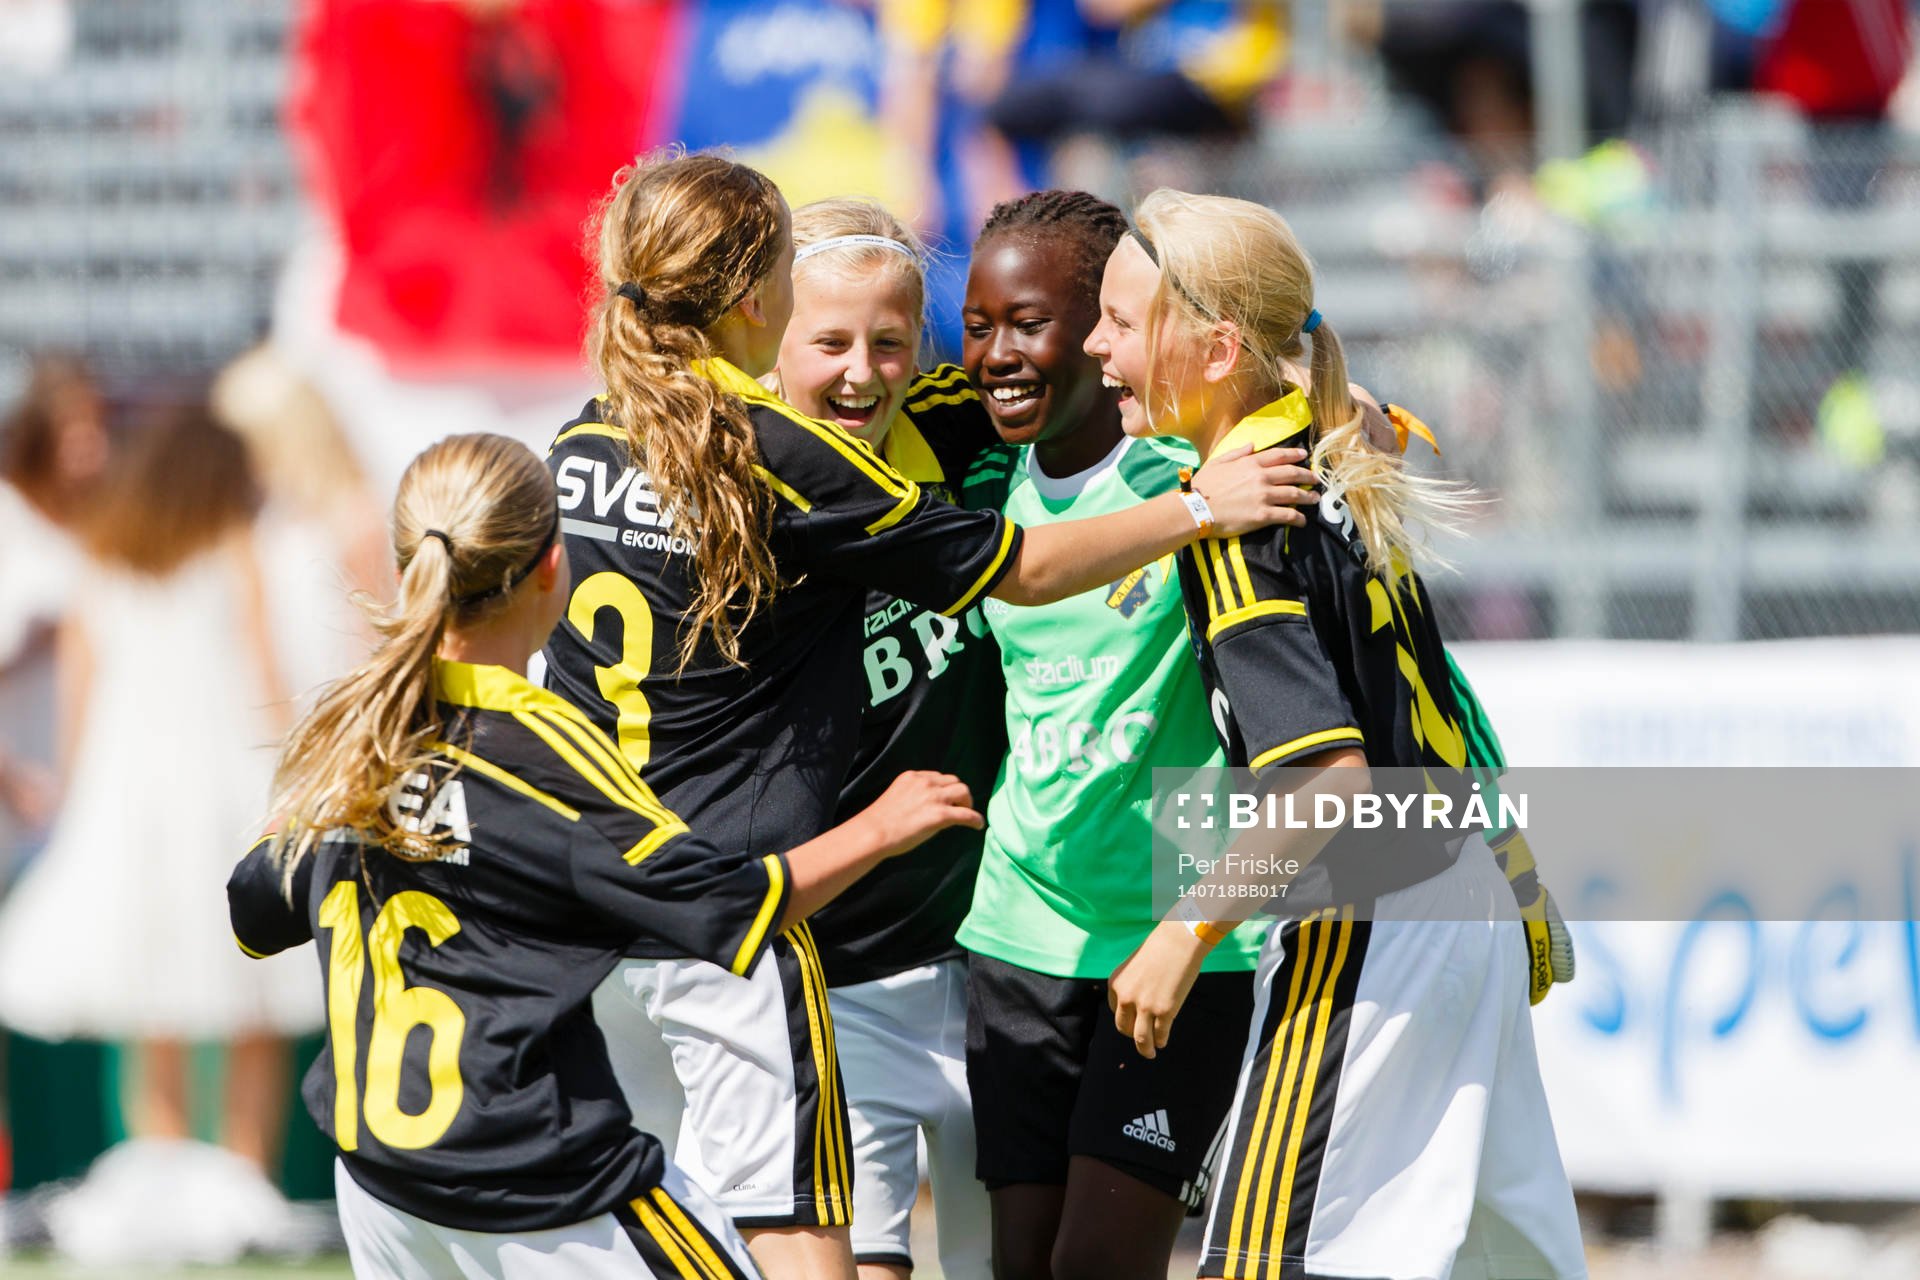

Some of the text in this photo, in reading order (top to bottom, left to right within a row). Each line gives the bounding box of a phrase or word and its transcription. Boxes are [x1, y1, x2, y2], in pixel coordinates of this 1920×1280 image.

[1025, 654, 1120, 687] stadium
[318, 880, 467, 1152] 16
[1122, 1123, 1176, 1152] adidas
